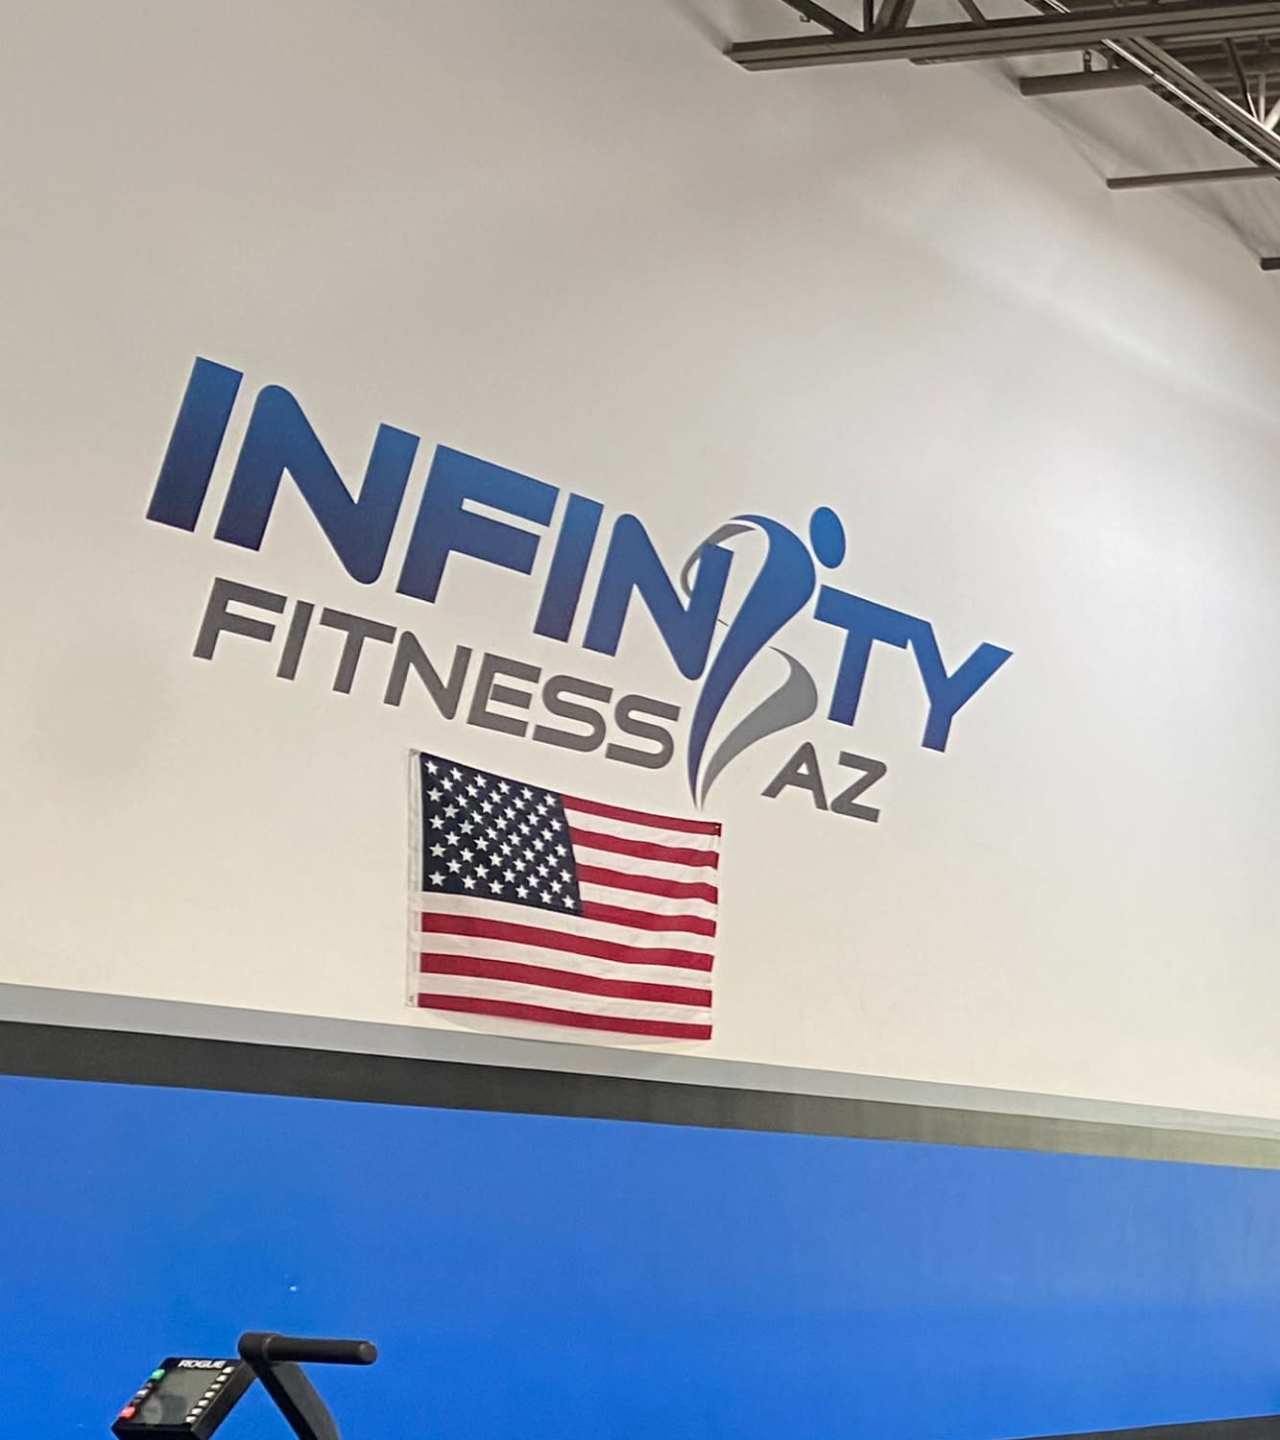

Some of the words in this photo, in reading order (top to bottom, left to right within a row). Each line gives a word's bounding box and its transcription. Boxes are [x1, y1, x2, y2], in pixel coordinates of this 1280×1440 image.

[145, 356, 1013, 753] INFINITY
[192, 576, 682, 770] FITNESS
[761, 741, 888, 823] AZ
[178, 1360, 226, 1369] ROGUE
